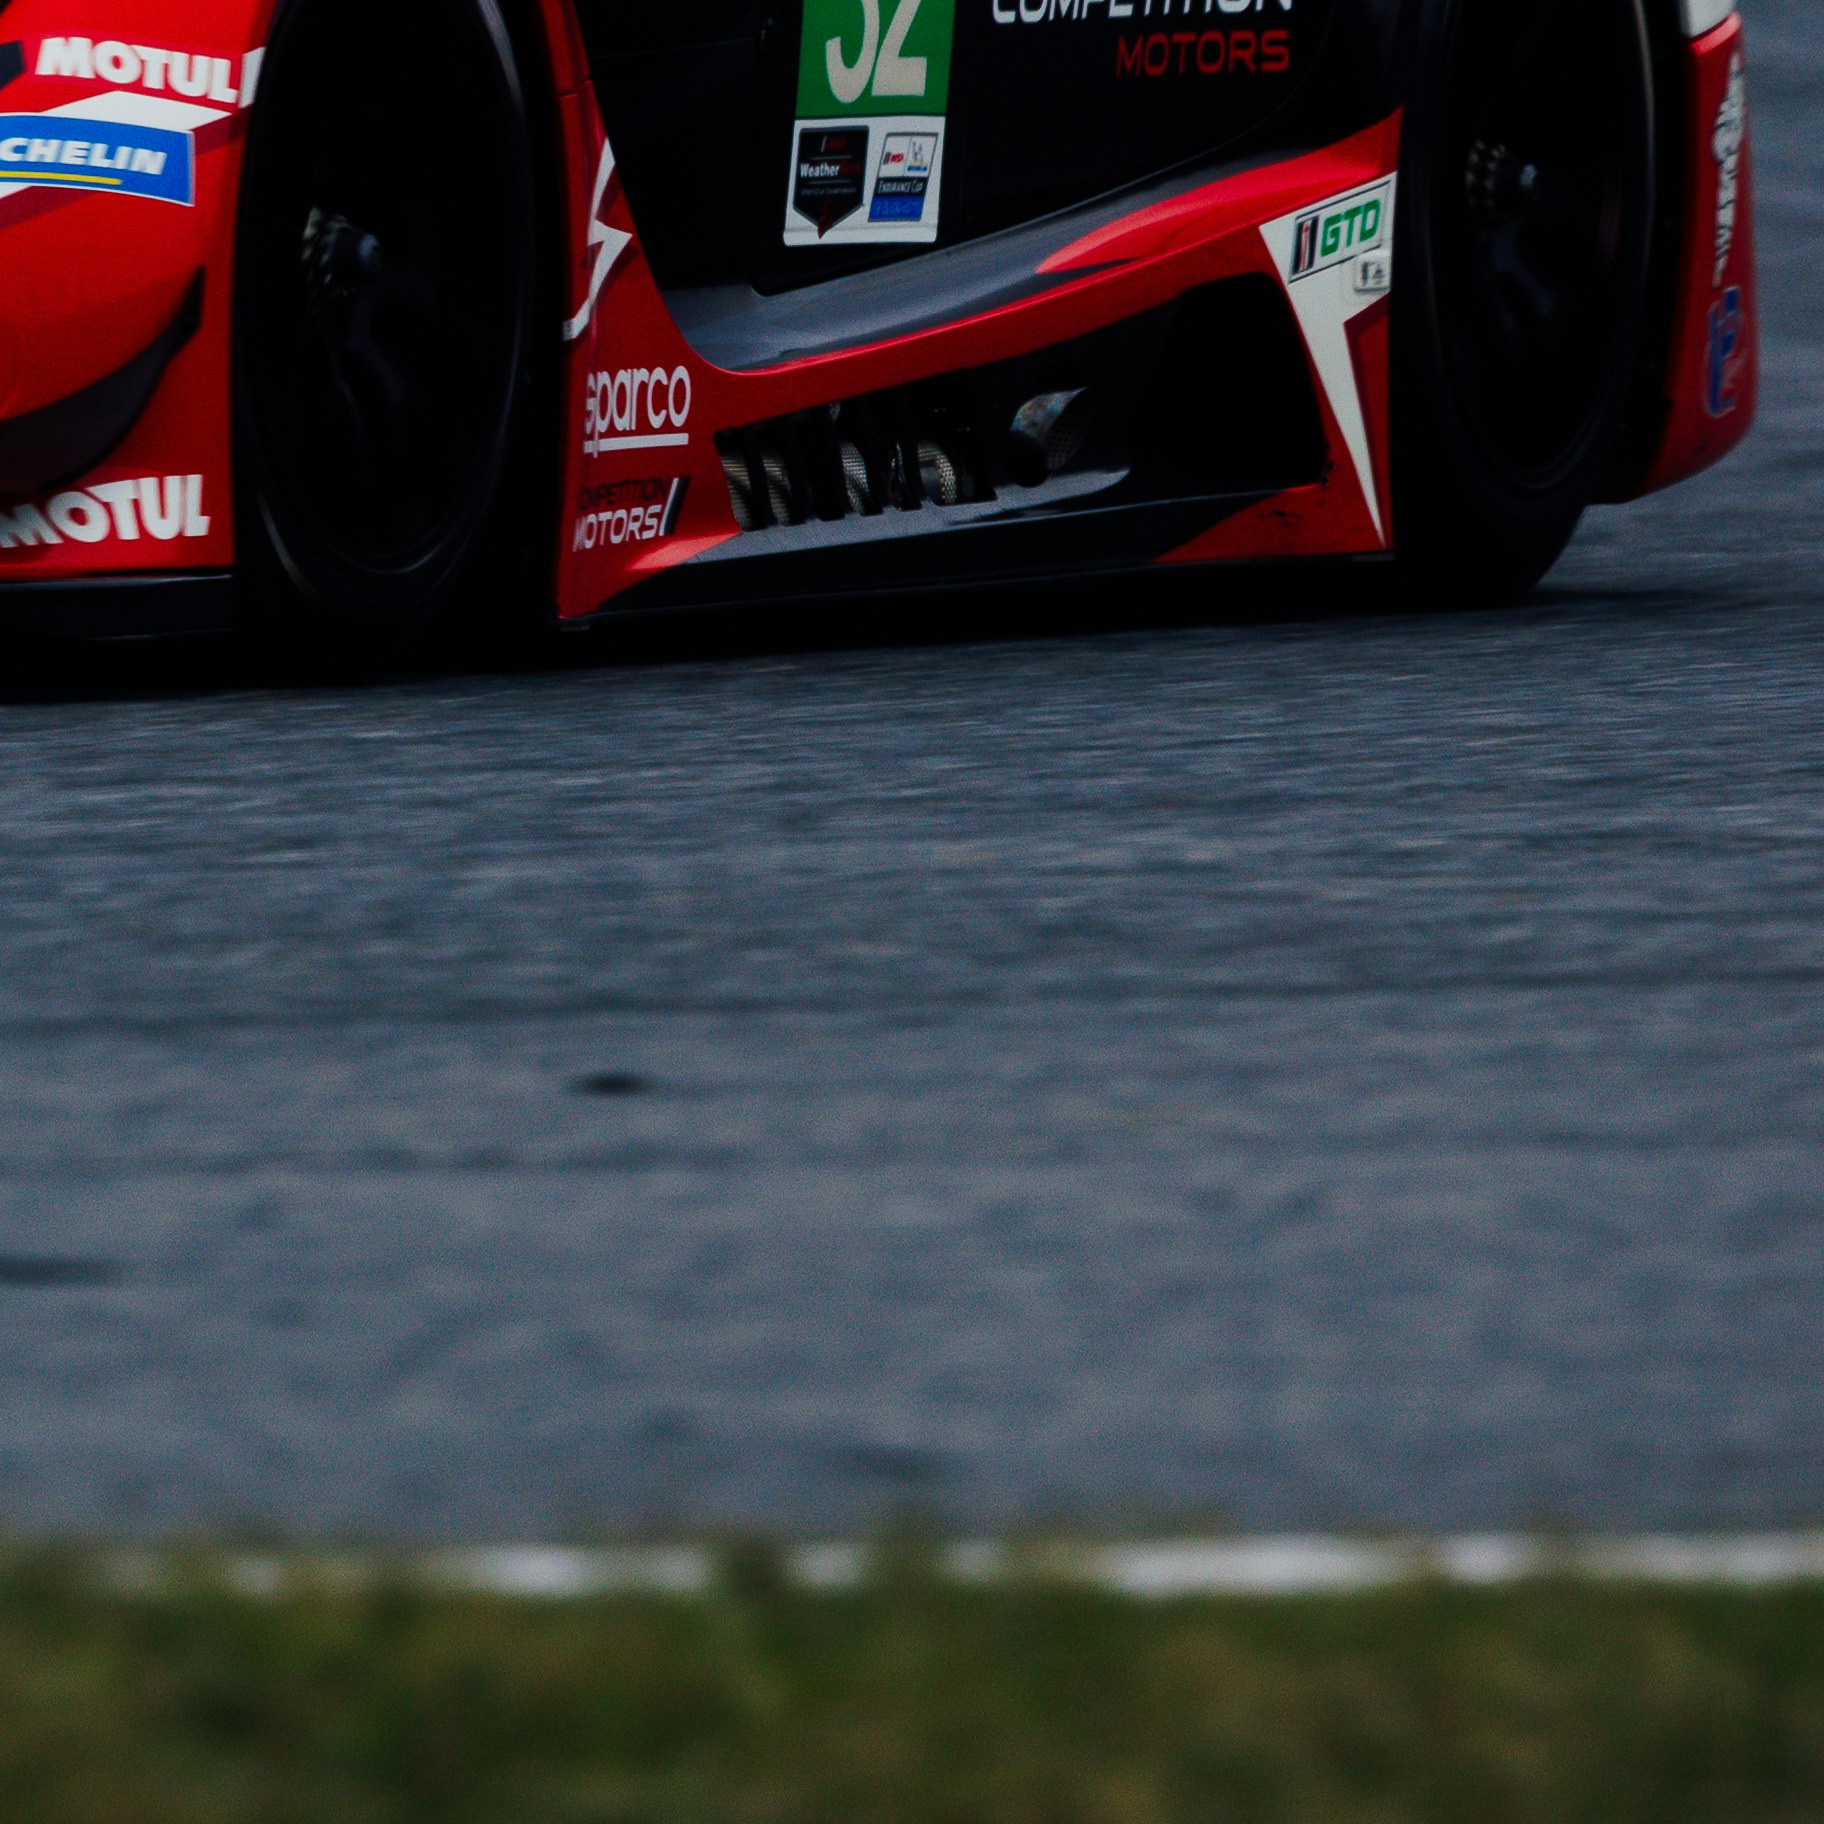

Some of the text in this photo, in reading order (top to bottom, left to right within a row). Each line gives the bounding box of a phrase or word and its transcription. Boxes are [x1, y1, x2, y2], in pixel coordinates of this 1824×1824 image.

[34, 35, 240, 104] MOTUL
[1116, 29, 1291, 78] MOTORS
[1320, 199, 1381, 257] GTD
[584, 365, 692, 458] sparco
